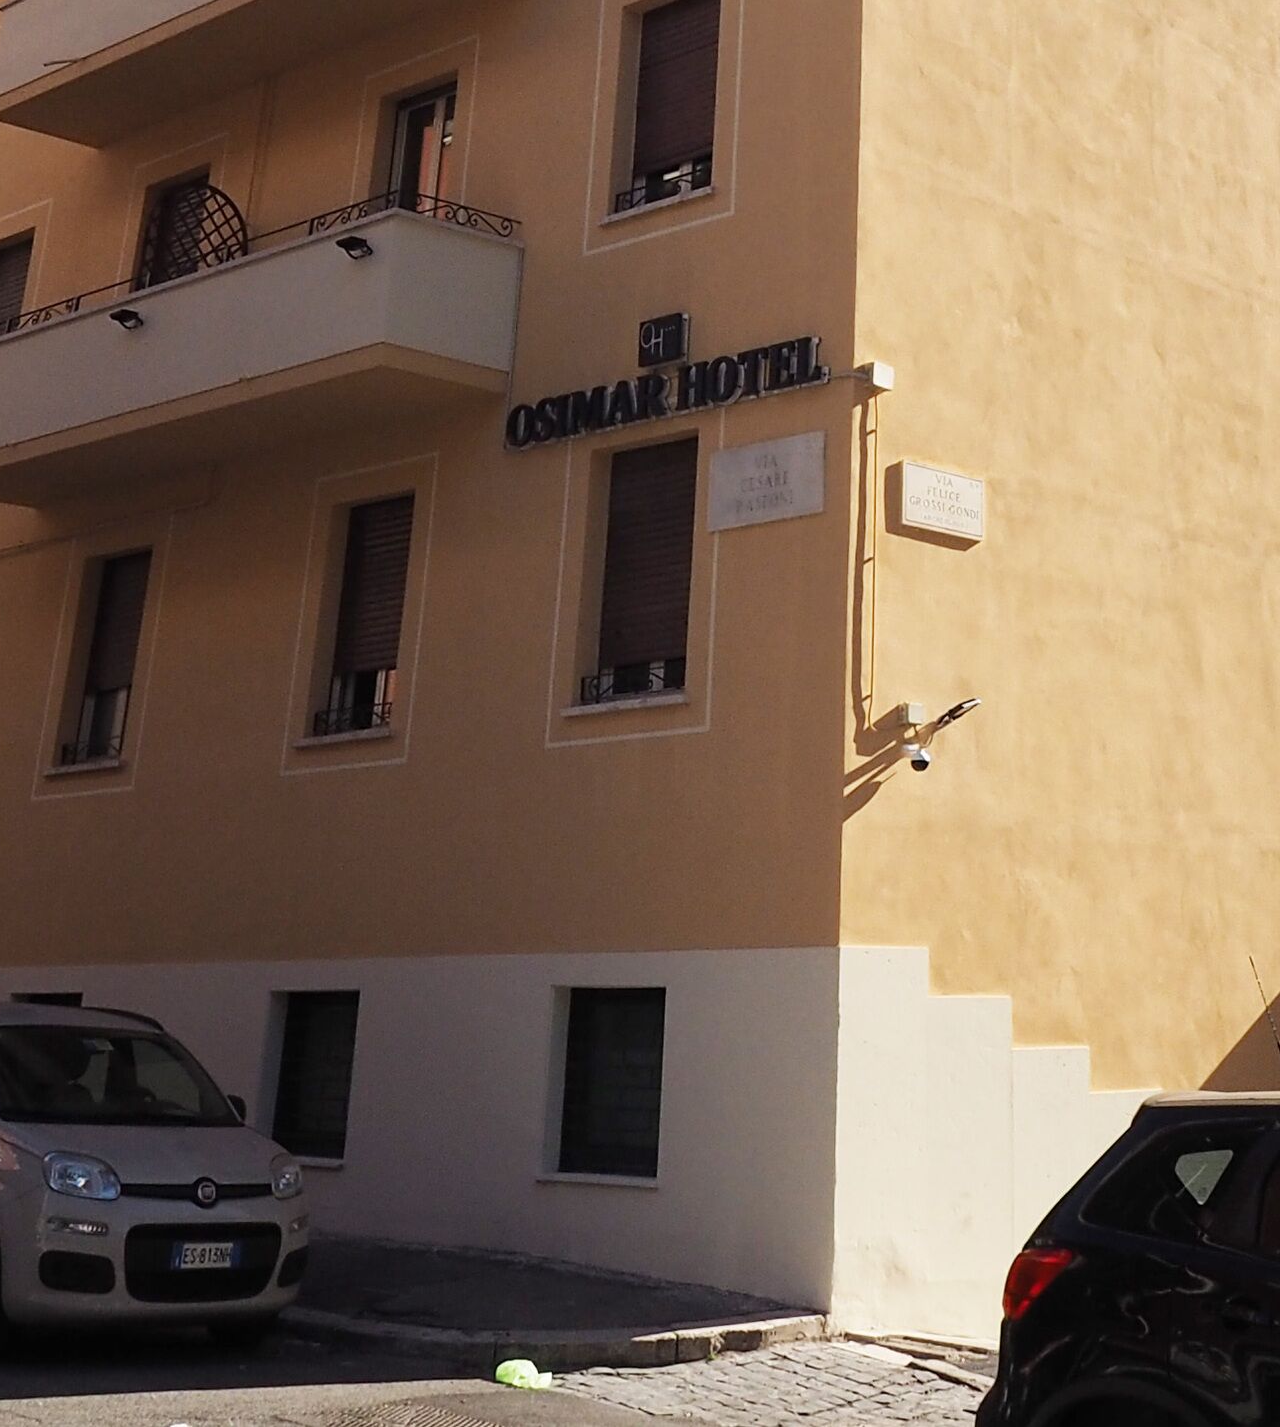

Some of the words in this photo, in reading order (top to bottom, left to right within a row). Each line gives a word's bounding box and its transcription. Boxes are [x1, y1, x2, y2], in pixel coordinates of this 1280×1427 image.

[506, 372, 674, 450] OSIMAR
[677, 336, 831, 411] HOTEL
[756, 455, 778, 469] VIA
[934, 473, 954, 488] VIA
[927, 485, 961, 503] FELICE
